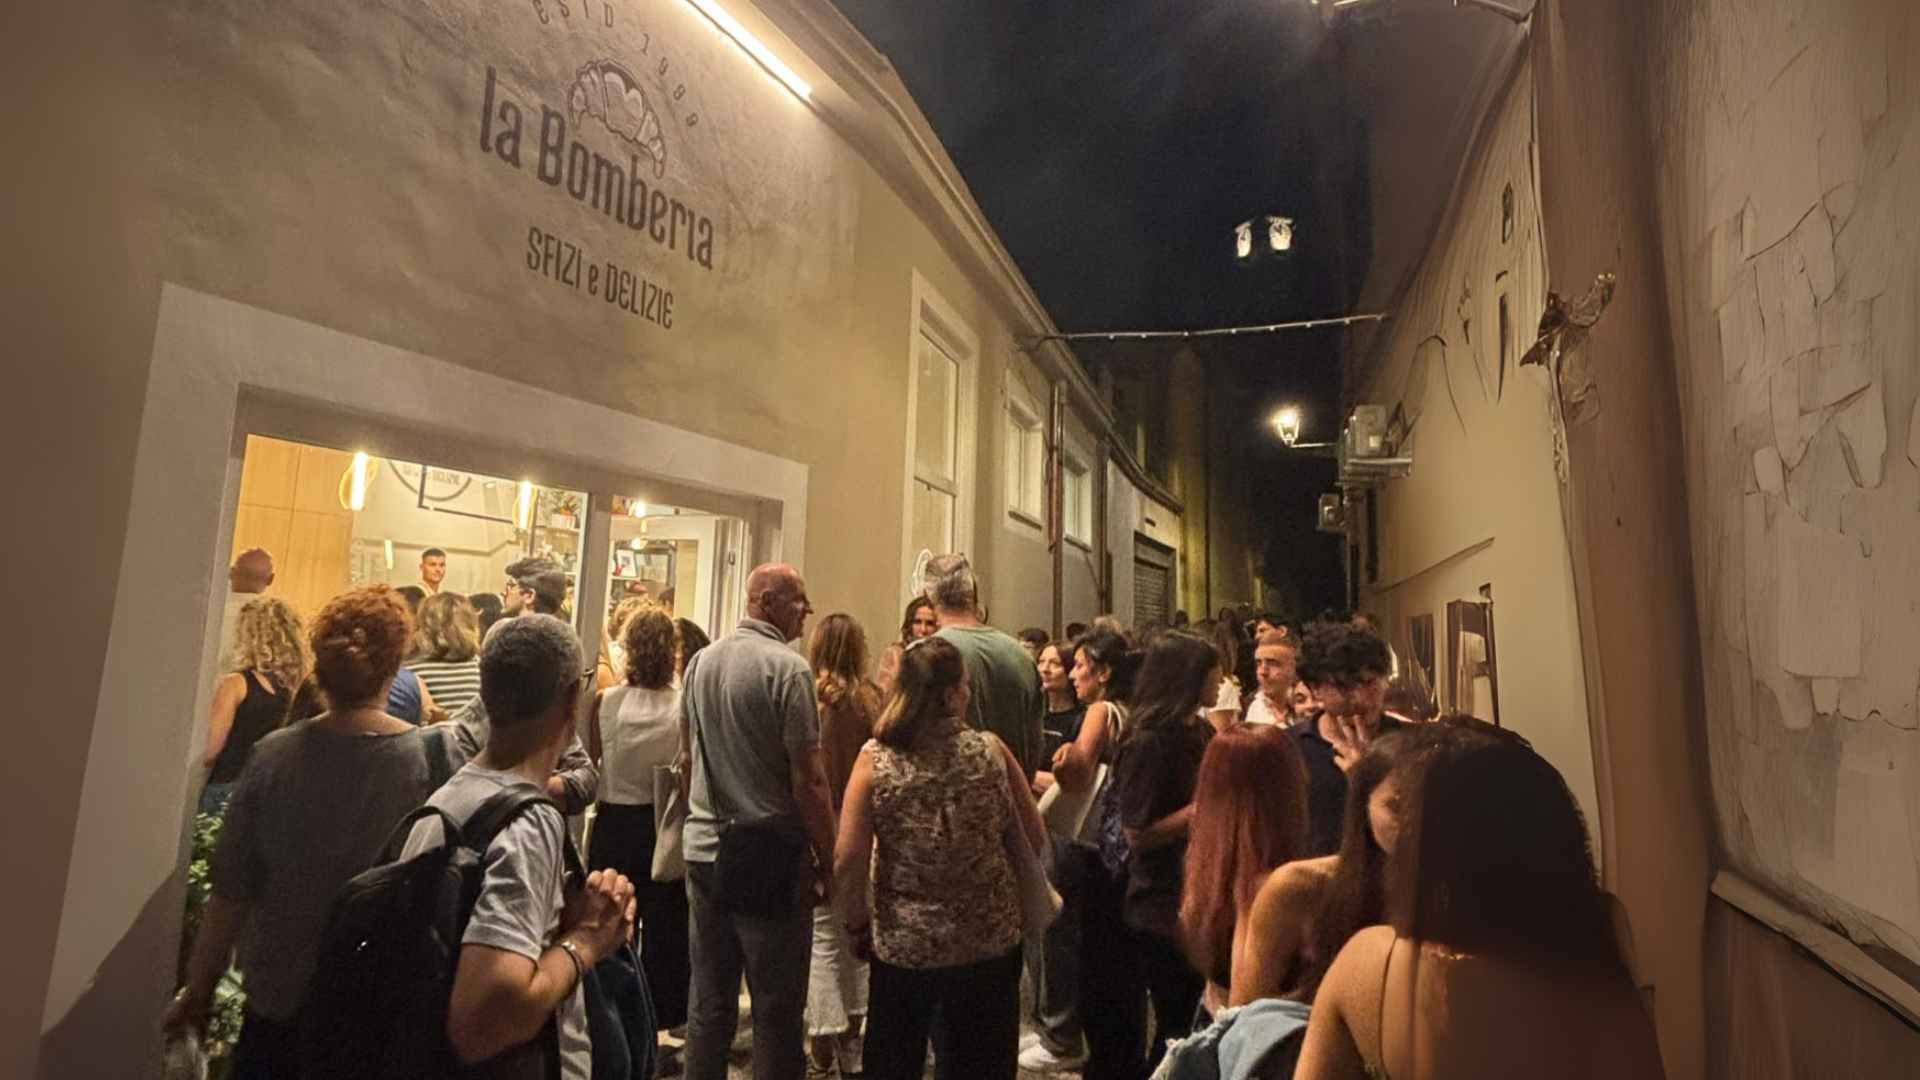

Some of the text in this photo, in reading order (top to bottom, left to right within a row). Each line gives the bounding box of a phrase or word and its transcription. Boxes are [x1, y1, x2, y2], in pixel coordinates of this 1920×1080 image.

[479, 65, 713, 271] la Bomberia
[526, 226, 674, 330] SFIZI e DELIZIE
